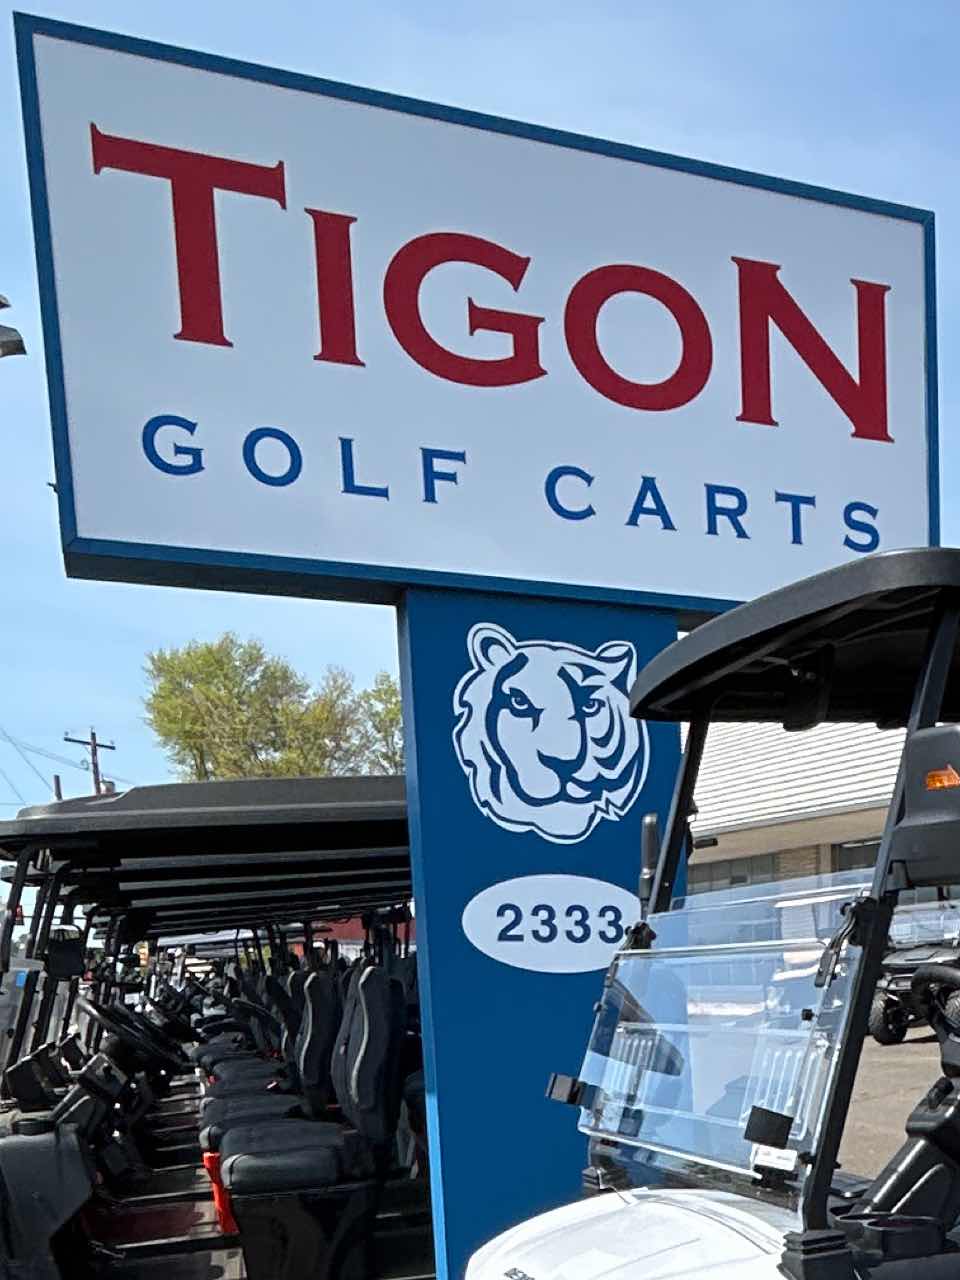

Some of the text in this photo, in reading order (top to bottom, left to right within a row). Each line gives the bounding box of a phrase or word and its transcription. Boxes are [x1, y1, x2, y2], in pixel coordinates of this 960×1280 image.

[91, 122, 895, 443] TIGON
[142, 414, 881, 552] GOLF CARTS
[496, 903, 625, 944] 2333
